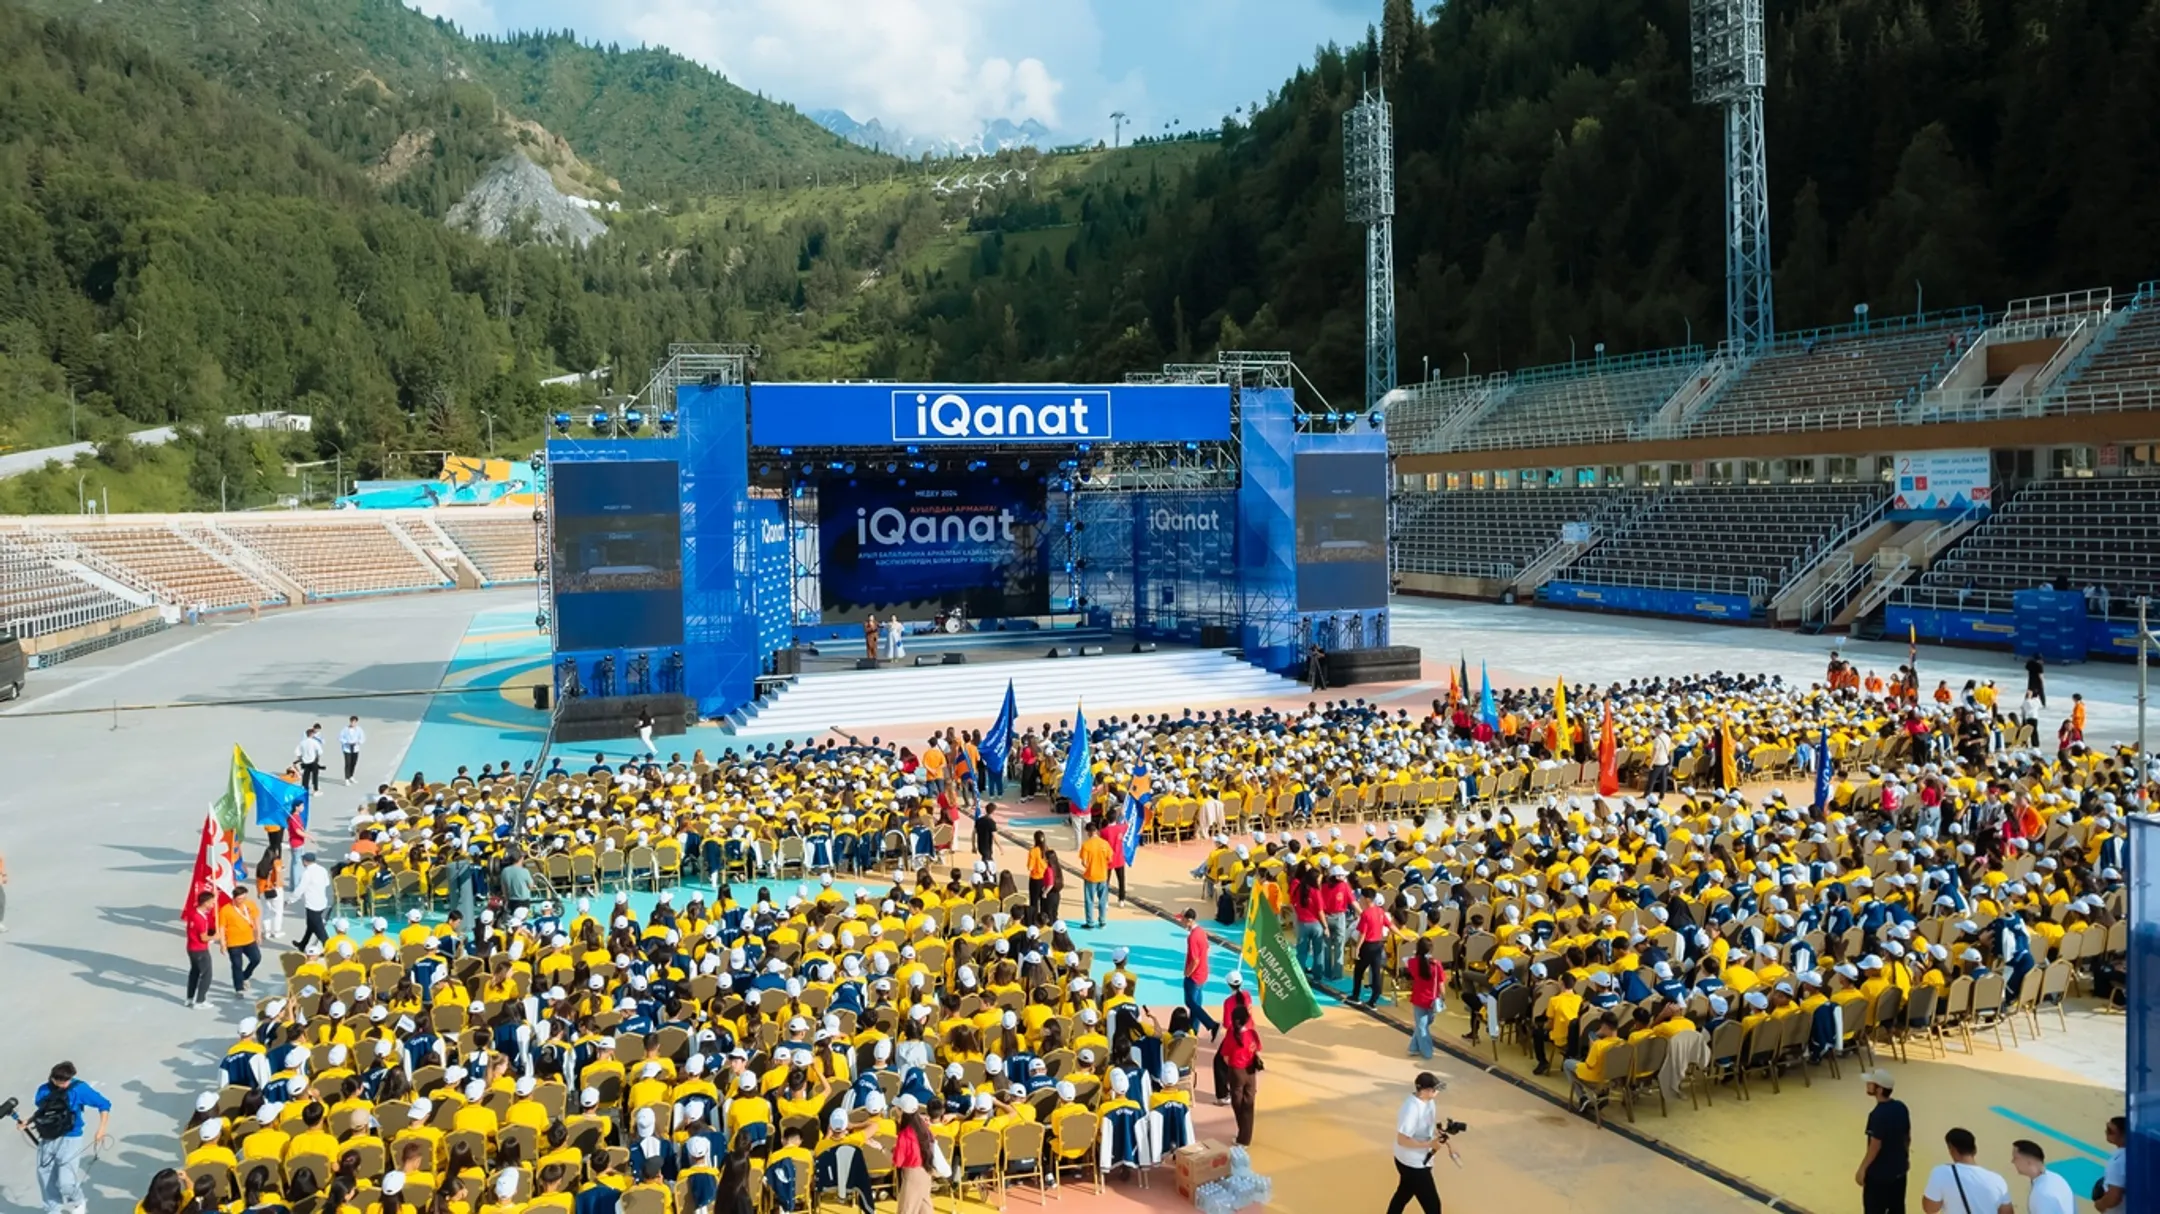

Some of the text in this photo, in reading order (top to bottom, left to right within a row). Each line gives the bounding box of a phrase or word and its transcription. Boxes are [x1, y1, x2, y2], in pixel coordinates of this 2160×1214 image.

[916, 393, 1089, 437] iQanat
[761, 518, 786, 544] iQanat
[857, 507, 1015, 546] iQanat
[1149, 508, 1220, 531] iQanat
[1258, 945, 1297, 993] АЛМАТЫ
[1259, 961, 1291, 1001] ЛЫСЫ
